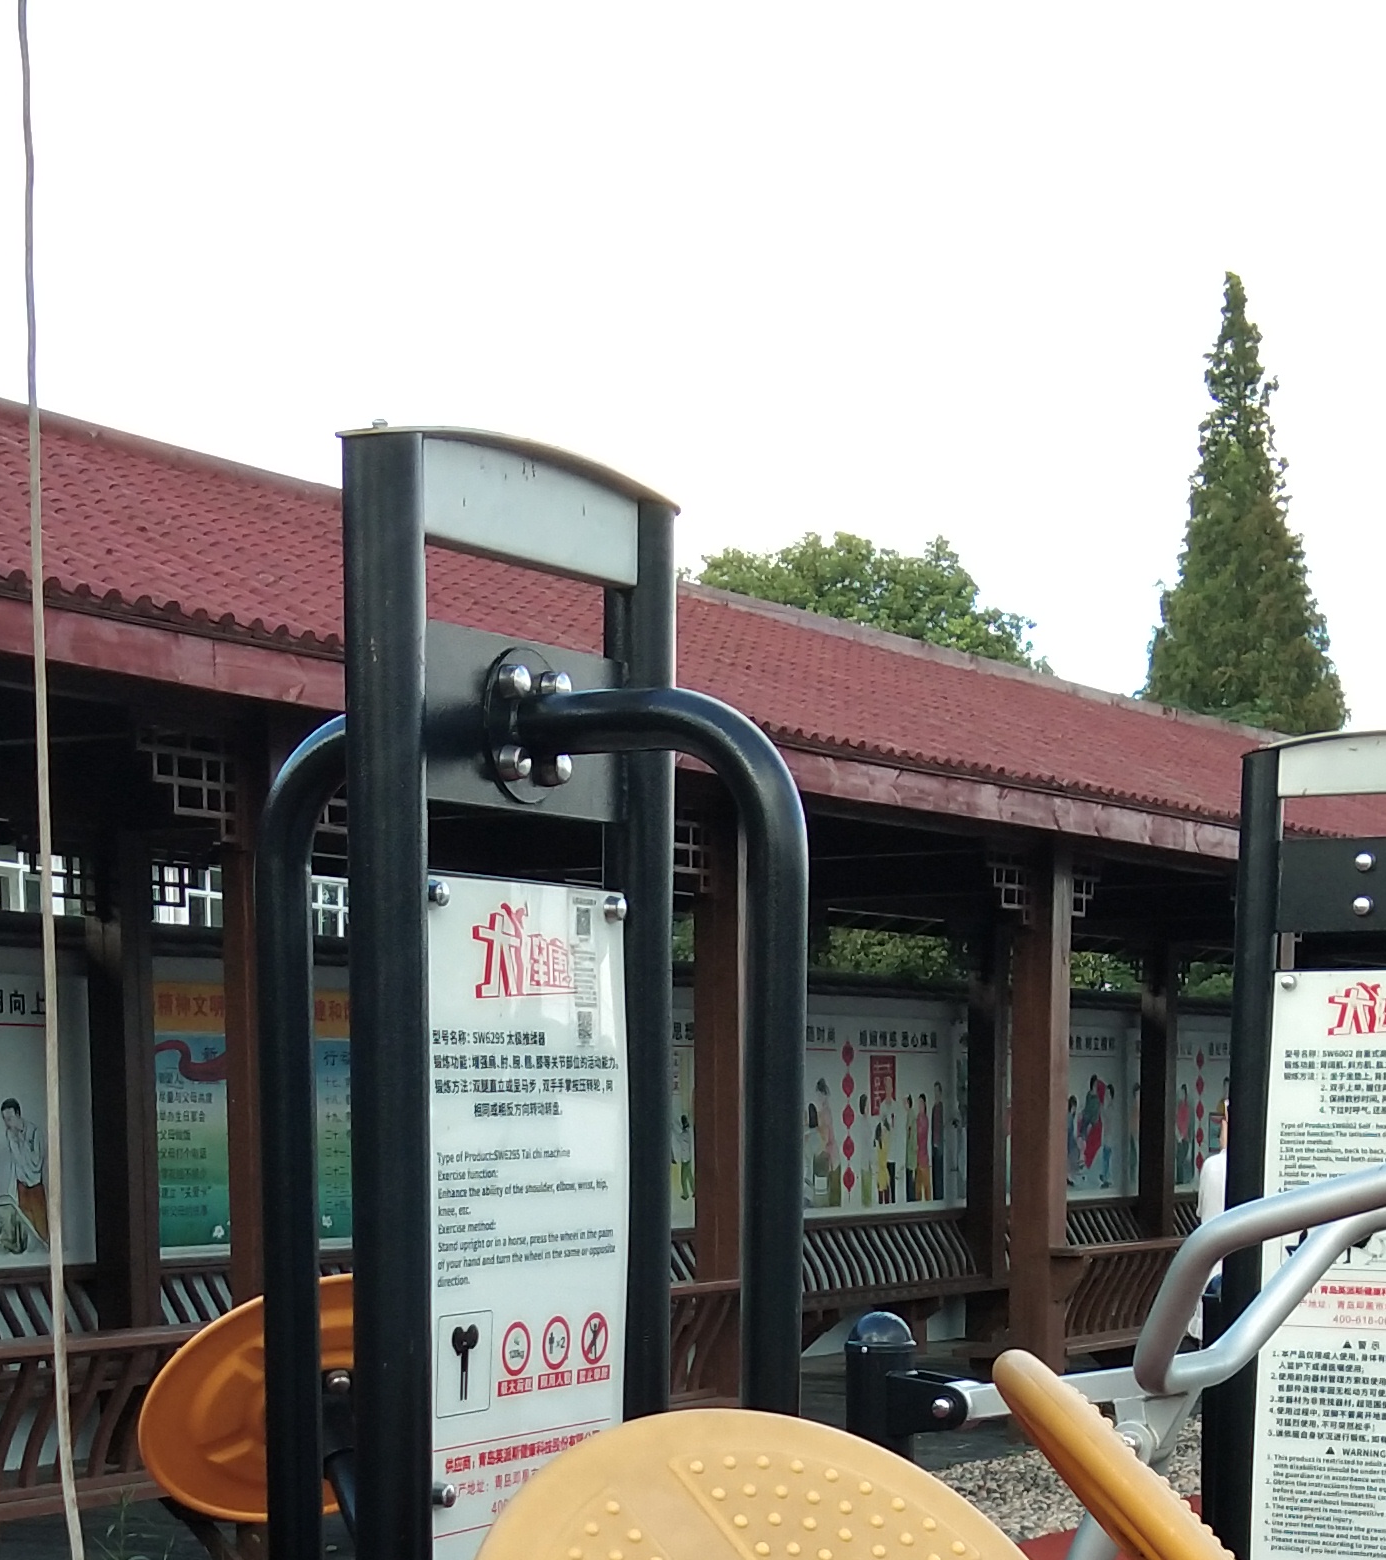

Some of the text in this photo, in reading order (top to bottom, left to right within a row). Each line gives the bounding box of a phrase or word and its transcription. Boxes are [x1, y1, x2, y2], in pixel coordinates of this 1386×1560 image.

[437, 1151, 454, 1165] Type
[455, 1151, 464, 1162] of
[438, 1170, 466, 1181] Exercise
[438, 1187, 467, 1199] Enhance
[469, 1186, 480, 1197] the
[504, 1184, 512, 1195] of
[513, 1182, 524, 1194] the
[438, 1222, 466, 1235] Exercise
[438, 1241, 458, 1252] Stand
[486, 1239, 494, 1249] or
[482, 1255, 495, 1265] and
[512, 1252, 523, 1263] the
[1342, 1448, 1386, 1458] WARNING
